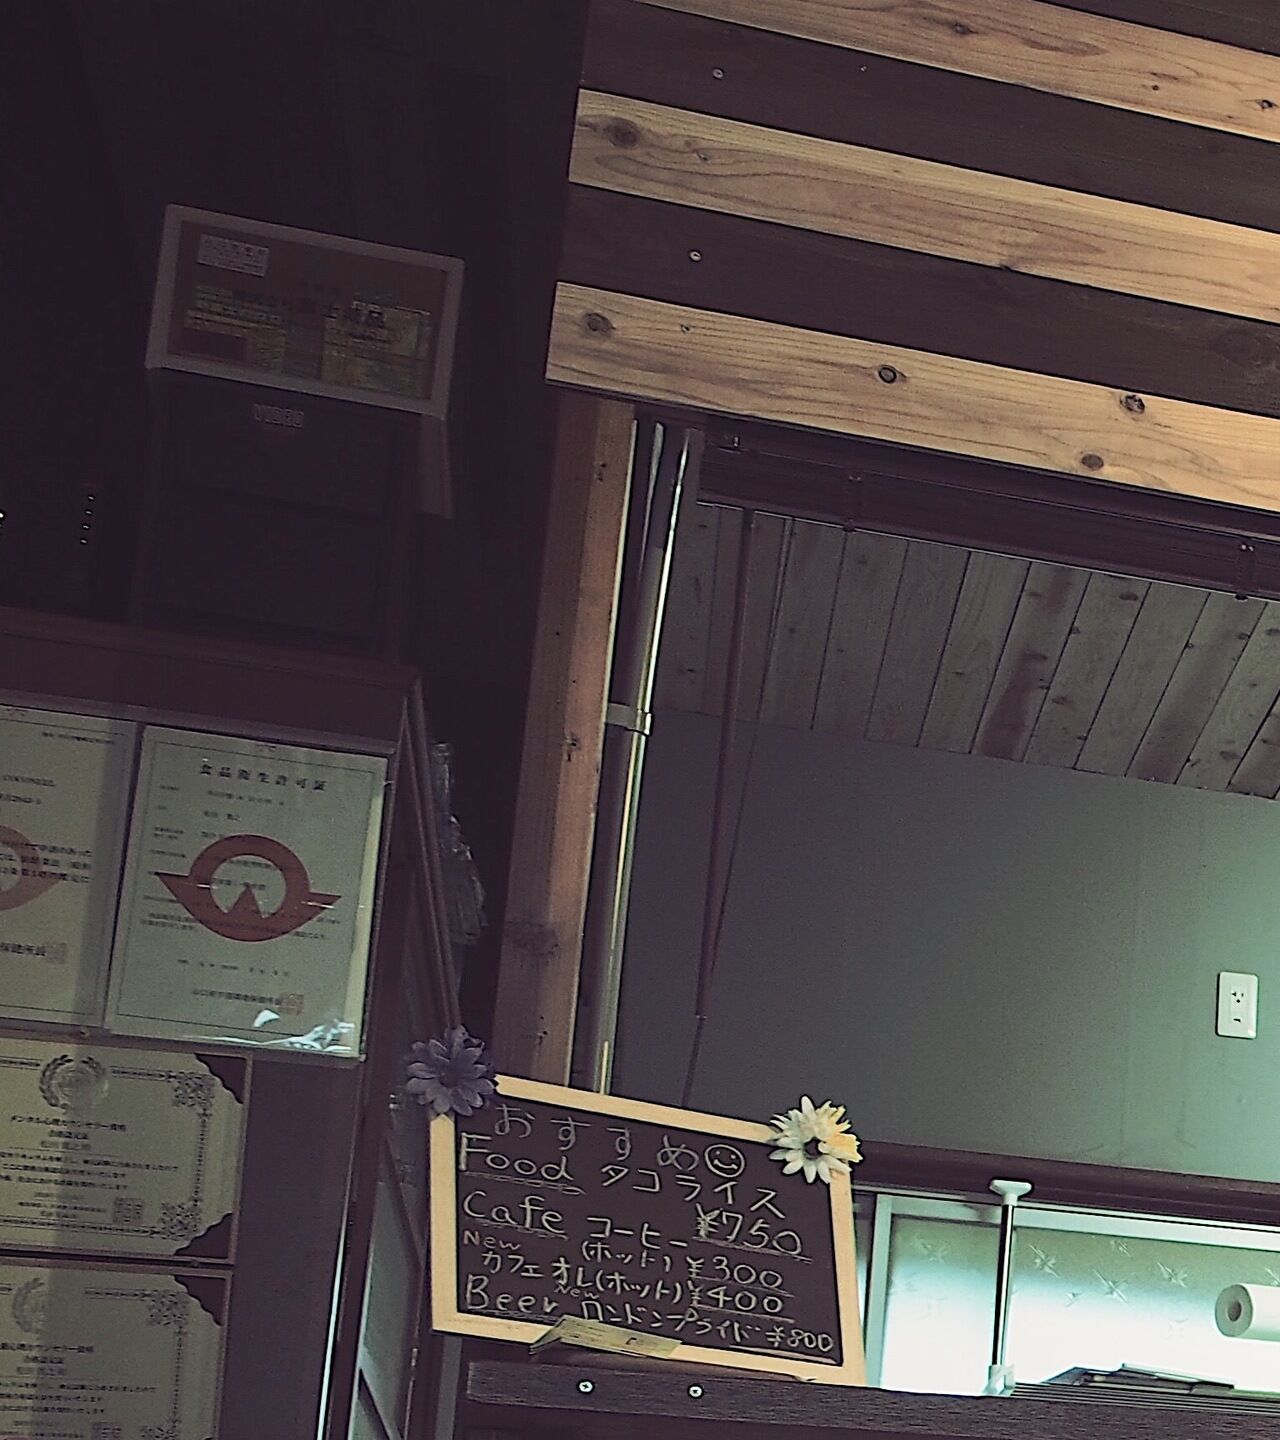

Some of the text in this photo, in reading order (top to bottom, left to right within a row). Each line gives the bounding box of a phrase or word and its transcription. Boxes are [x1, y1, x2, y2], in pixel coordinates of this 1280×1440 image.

[494, 1103, 699, 1172] おすすめ
[459, 1132, 575, 1181] Food
[600, 1164, 786, 1219] タコライス
[463, 1190, 567, 1234] Cafe
[695, 1203, 802, 1255] ¥750
[463, 1230, 521, 1250] New
[586, 1216, 688, 1250] コーヒー
[686, 1255, 784, 1289] ¥300
[465, 1273, 559, 1313] Beer
[554, 1284, 600, 1300] New
[686, 1279, 784, 1314] ¥400
[765, 1325, 835, 1352] ¥800
